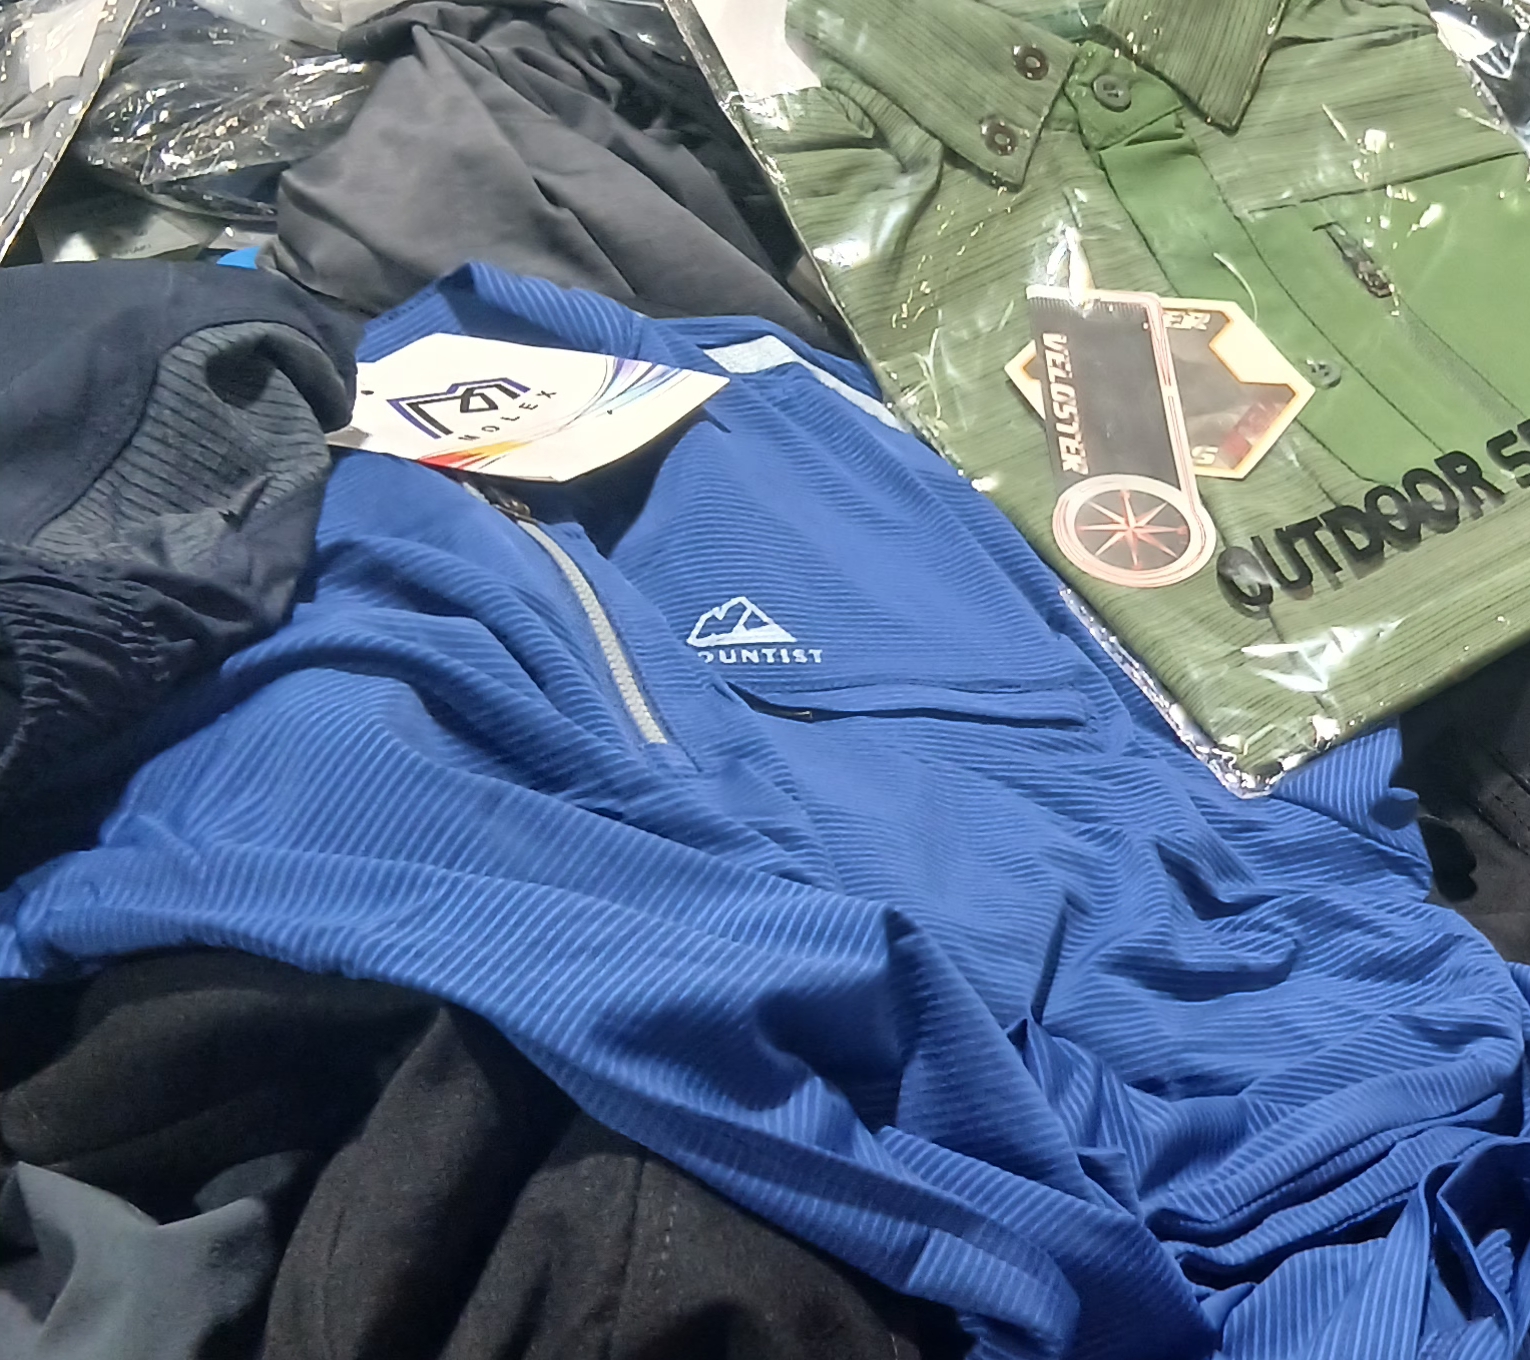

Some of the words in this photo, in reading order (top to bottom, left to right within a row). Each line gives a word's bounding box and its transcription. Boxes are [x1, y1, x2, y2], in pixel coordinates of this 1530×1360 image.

[1042, 332, 1089, 476] VELOSTER
[1216, 450, 1506, 612] OUTDOOR
[697, 647, 823, 665] OUNTIST
